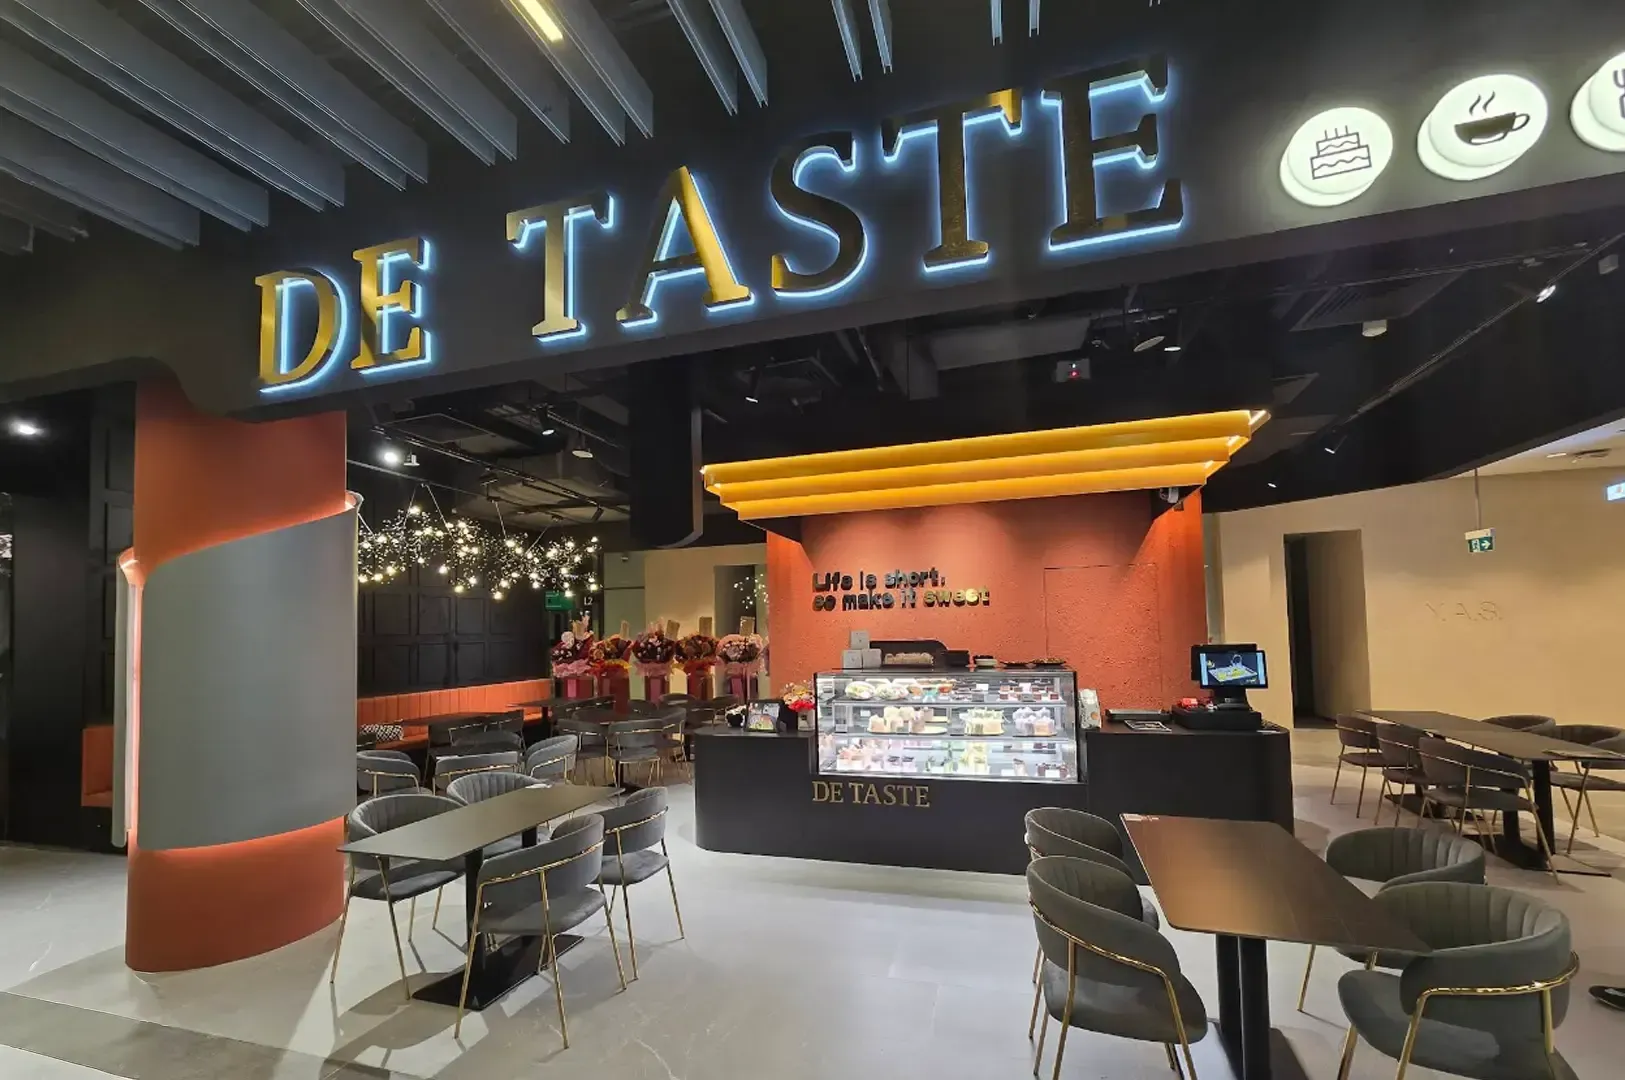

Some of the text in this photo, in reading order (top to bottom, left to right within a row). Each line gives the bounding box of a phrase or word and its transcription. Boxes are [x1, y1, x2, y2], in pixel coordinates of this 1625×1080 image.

[255, 55, 1184, 394] DE TASTE
[812, 571, 853, 592] Life
[860, 571, 877, 590] is
[812, 594, 836, 612] so
[842, 590, 894, 611] make
[901, 588, 916, 608] it
[811, 780, 931, 808] DE TASTE
